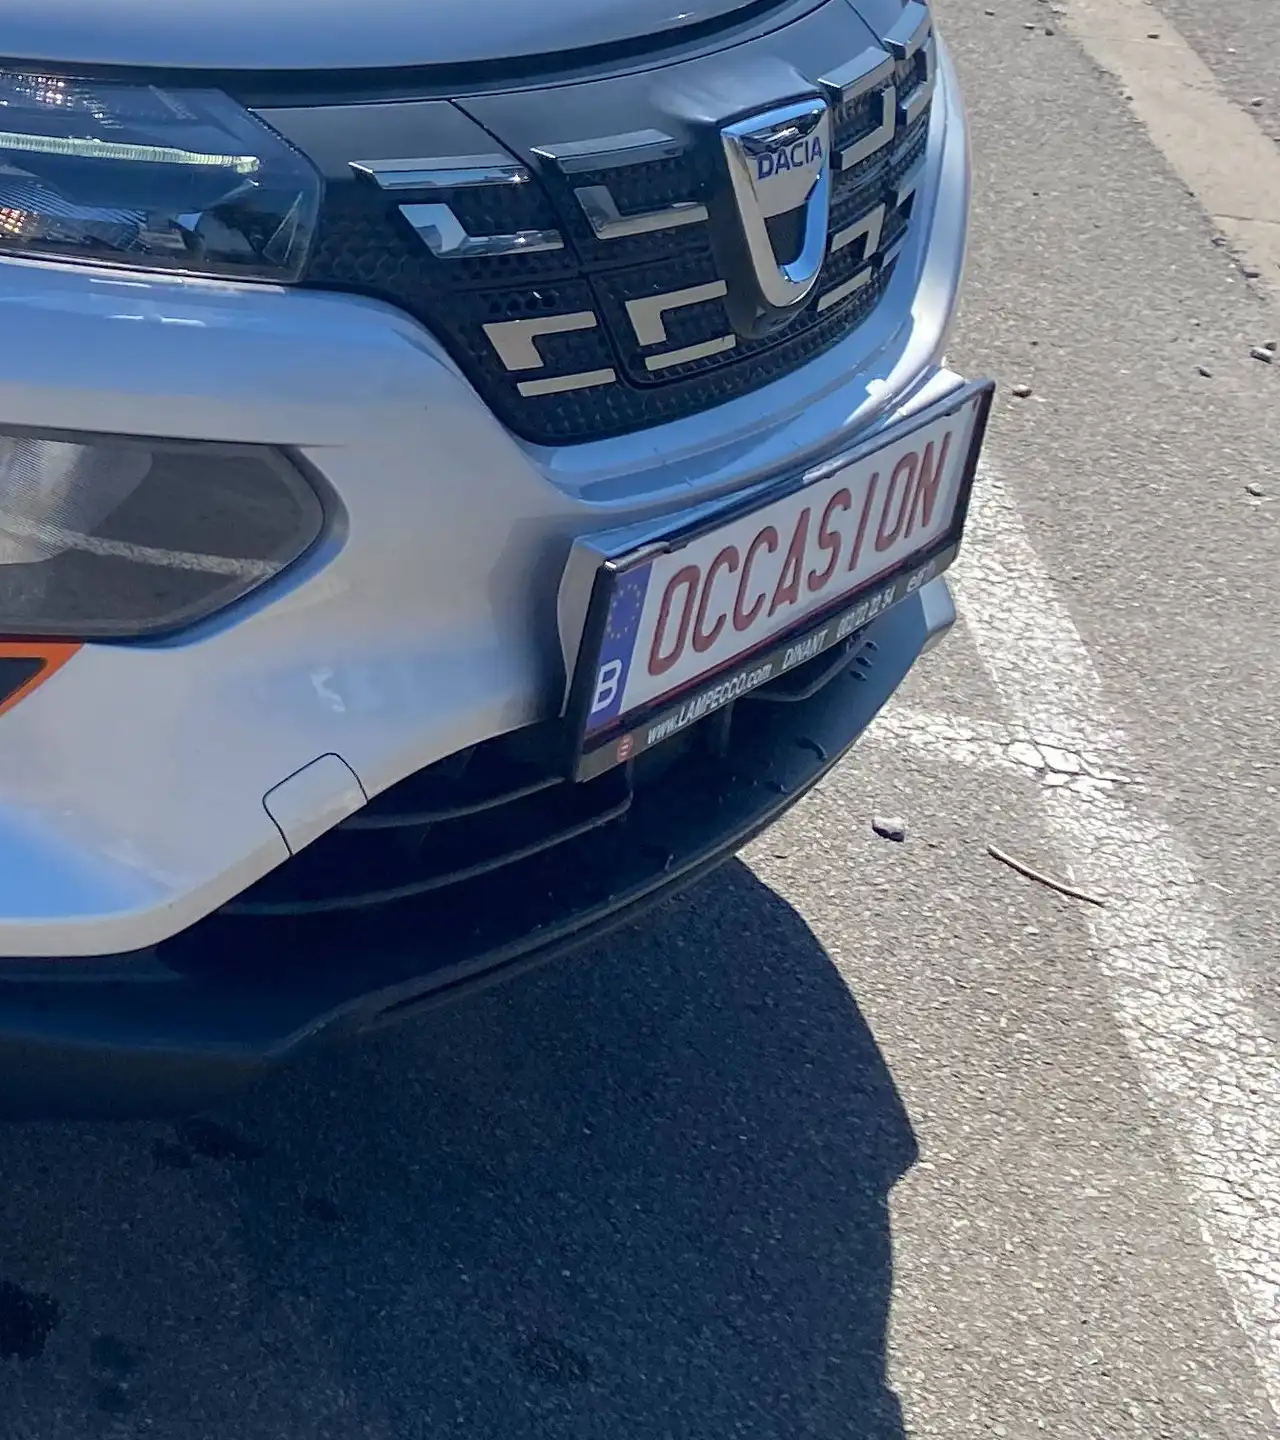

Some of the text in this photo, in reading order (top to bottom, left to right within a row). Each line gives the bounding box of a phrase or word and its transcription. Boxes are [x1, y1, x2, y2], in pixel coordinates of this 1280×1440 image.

[756, 136, 822, 180] DACIA
[648, 431, 951, 676] OCCASION
[591, 659, 622, 714] B
[647, 664, 772, 745] www.LAMPECCO.com
[782, 628, 828, 670] DINANT
